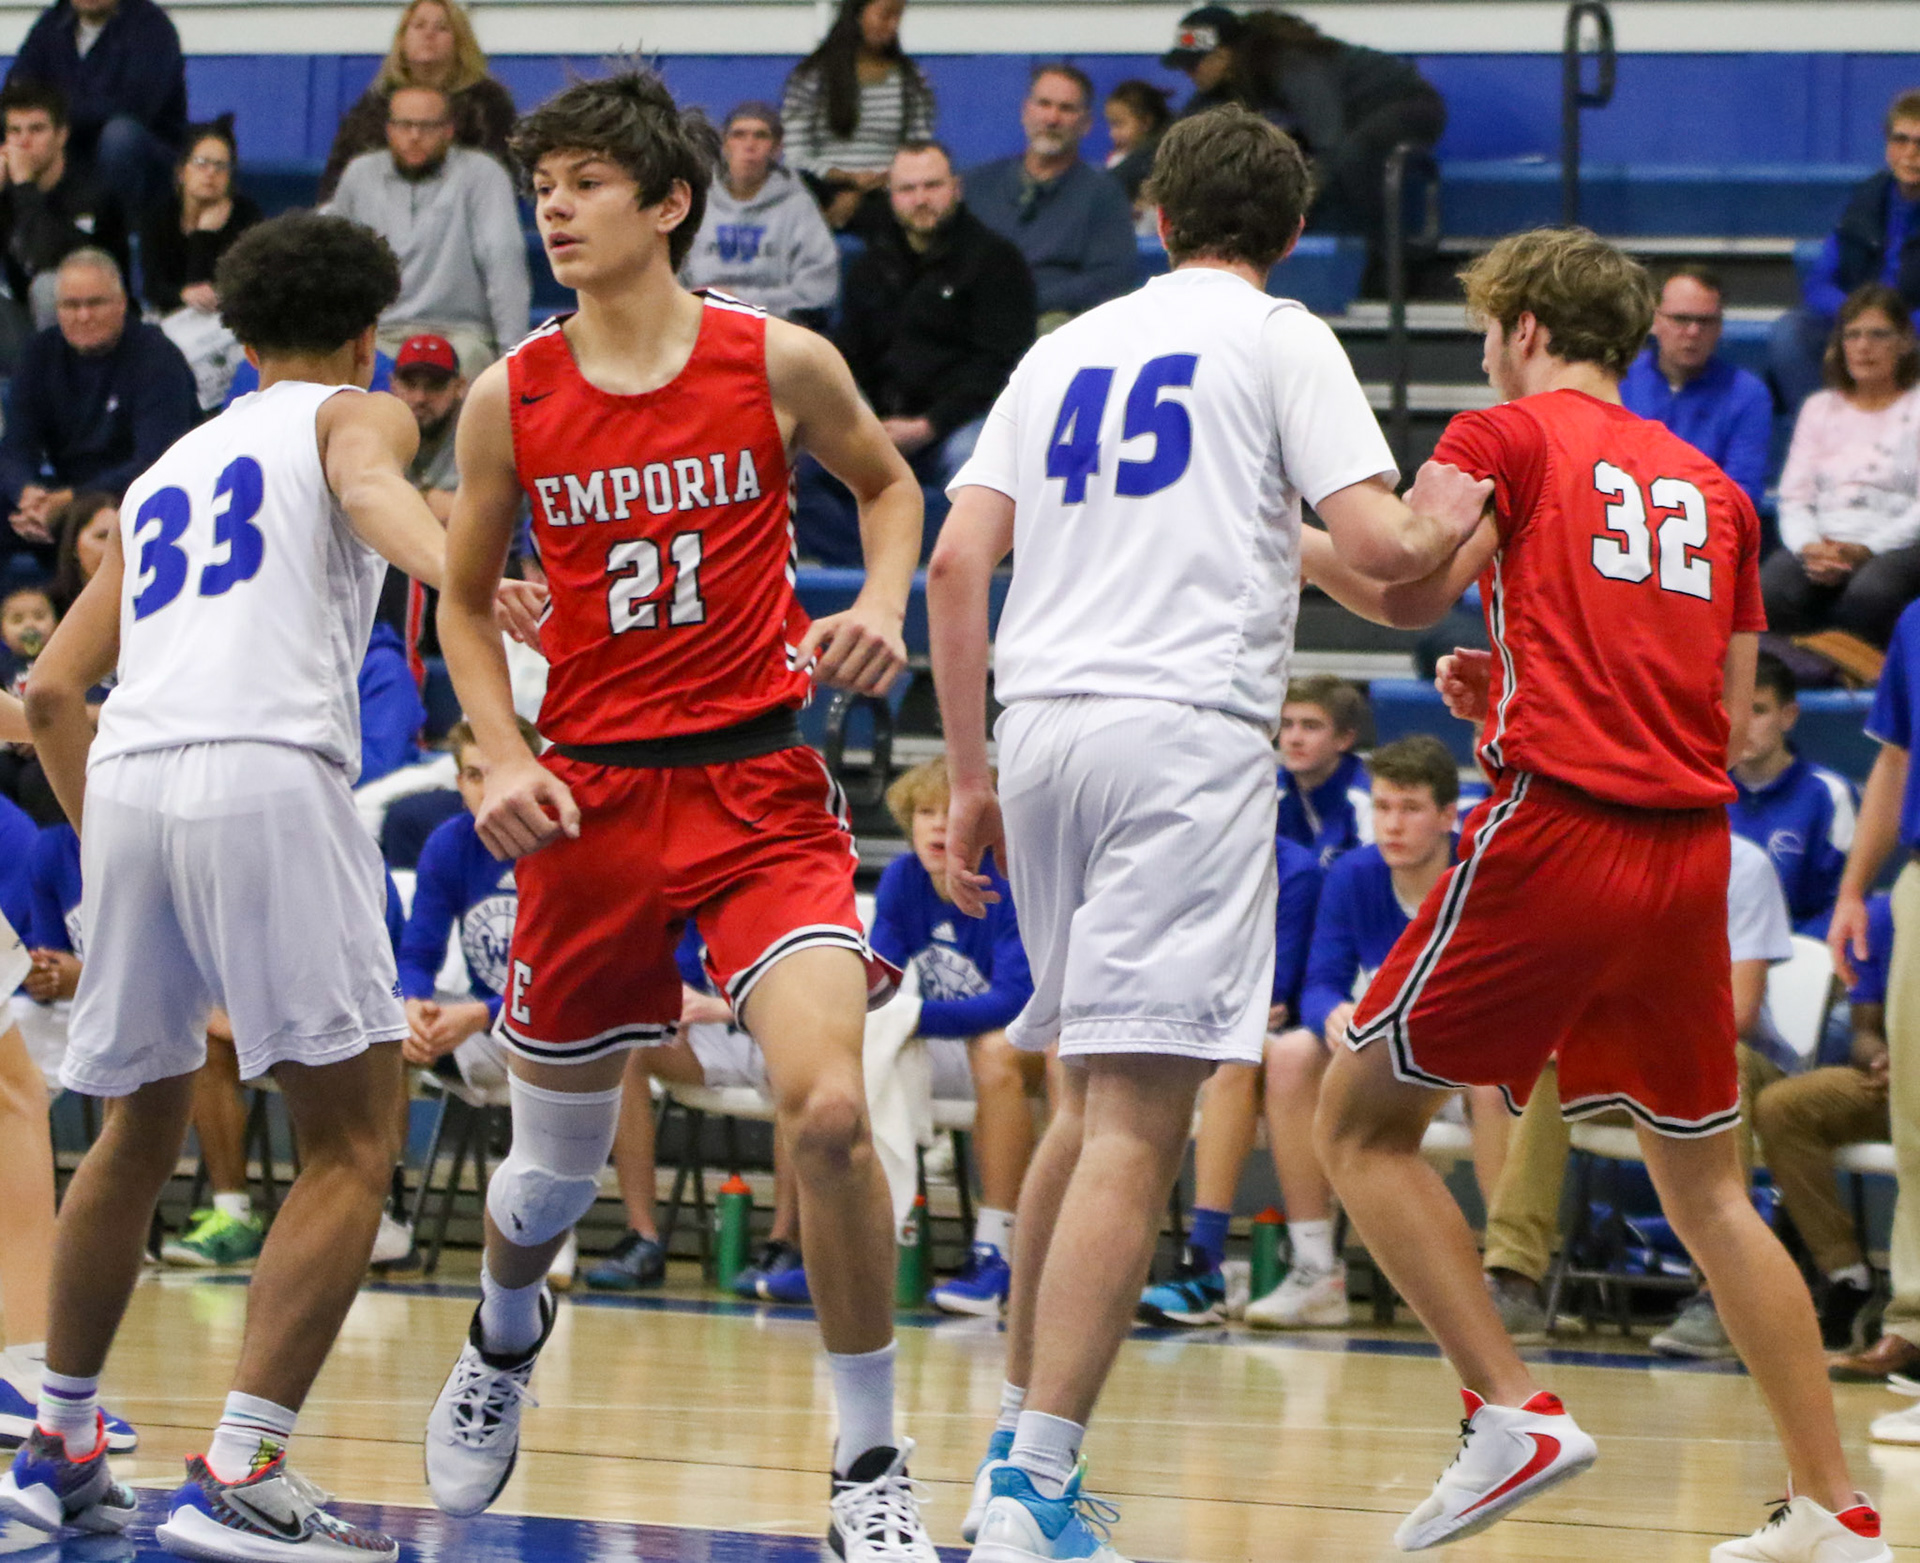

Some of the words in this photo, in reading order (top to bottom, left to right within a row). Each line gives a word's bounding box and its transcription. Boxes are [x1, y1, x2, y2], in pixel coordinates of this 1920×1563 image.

[534, 448, 761, 527] EMPORIA
[1045, 352, 1202, 507] 45
[132, 454, 265, 623] 33
[605, 530, 706, 636] 21
[1591, 458, 1712, 603] 32
[510, 958, 532, 1025] E
